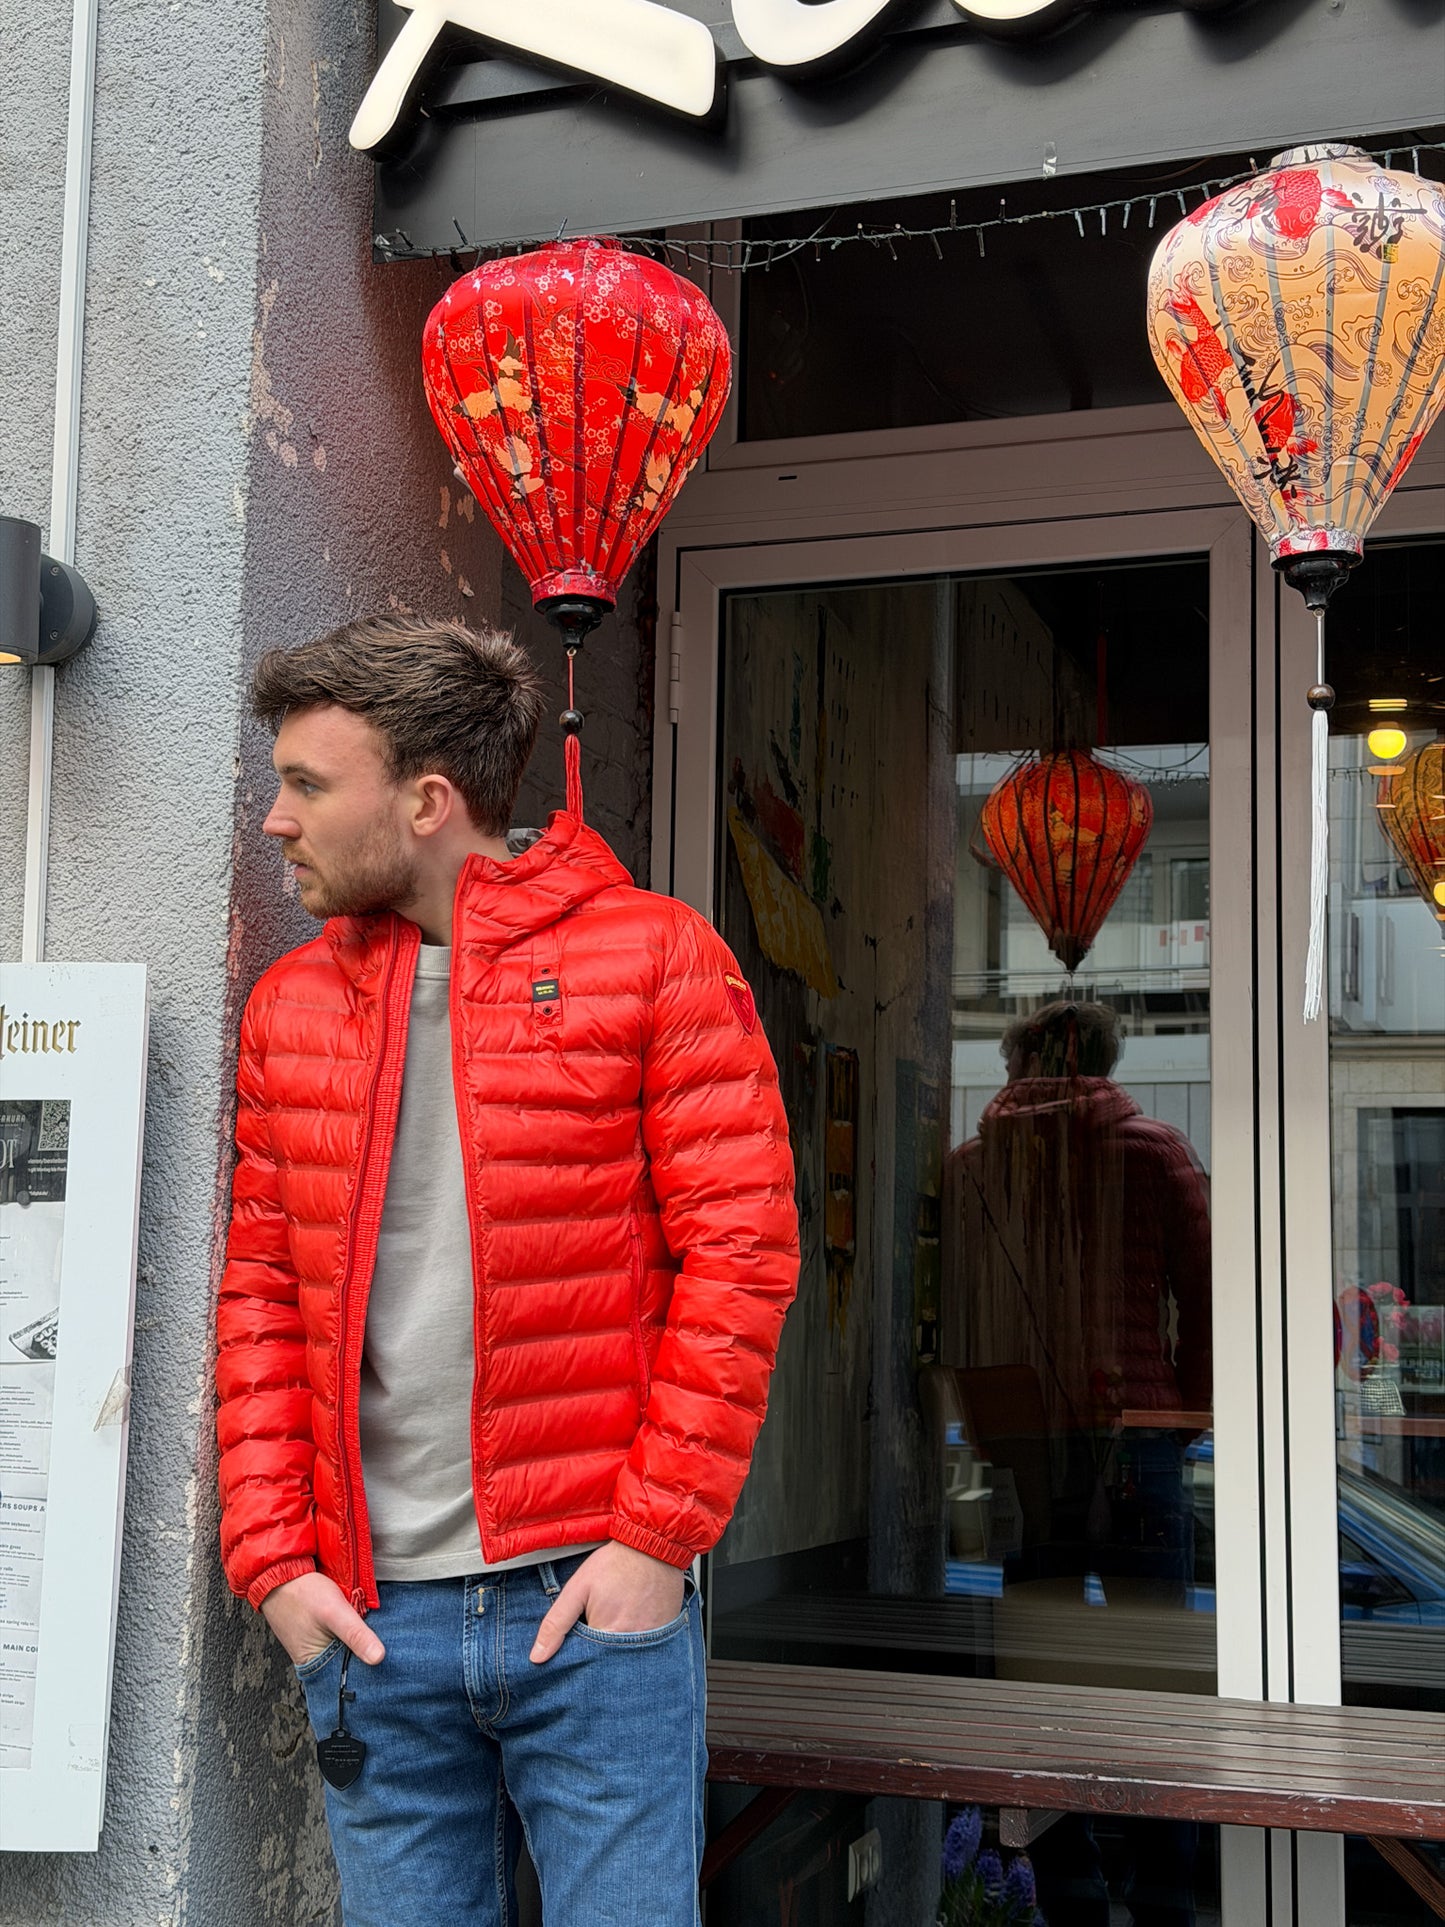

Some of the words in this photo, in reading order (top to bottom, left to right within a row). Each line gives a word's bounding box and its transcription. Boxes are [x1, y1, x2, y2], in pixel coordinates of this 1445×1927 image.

[0, 1114, 26, 1123] AKURA
[13, 1503, 37, 1511] SOUPS
[3, 1643, 24, 1651] MAIN
